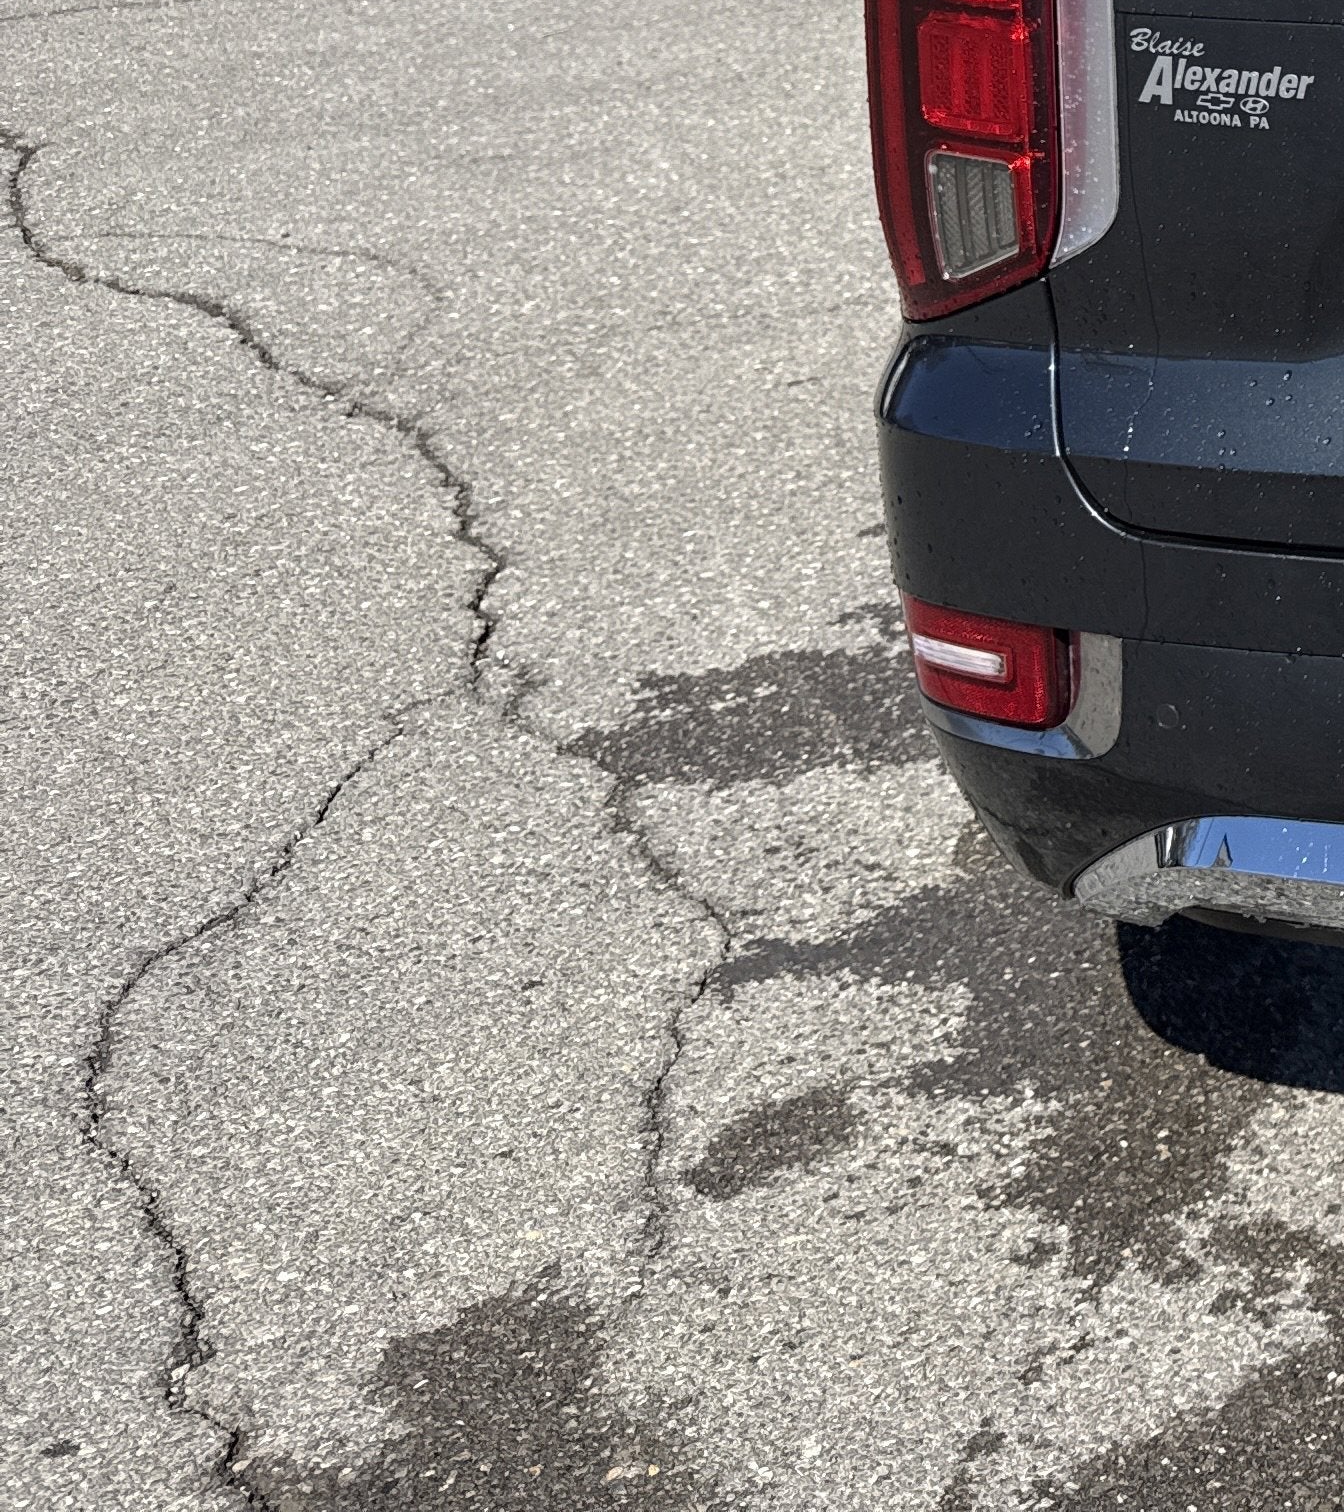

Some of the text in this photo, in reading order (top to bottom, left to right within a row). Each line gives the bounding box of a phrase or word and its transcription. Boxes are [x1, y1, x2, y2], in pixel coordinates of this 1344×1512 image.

[1129, 27, 1205, 56] Blaise
[1138, 54, 1315, 105] Alexander
[1173, 108, 1270, 130] ALTOONA PA
